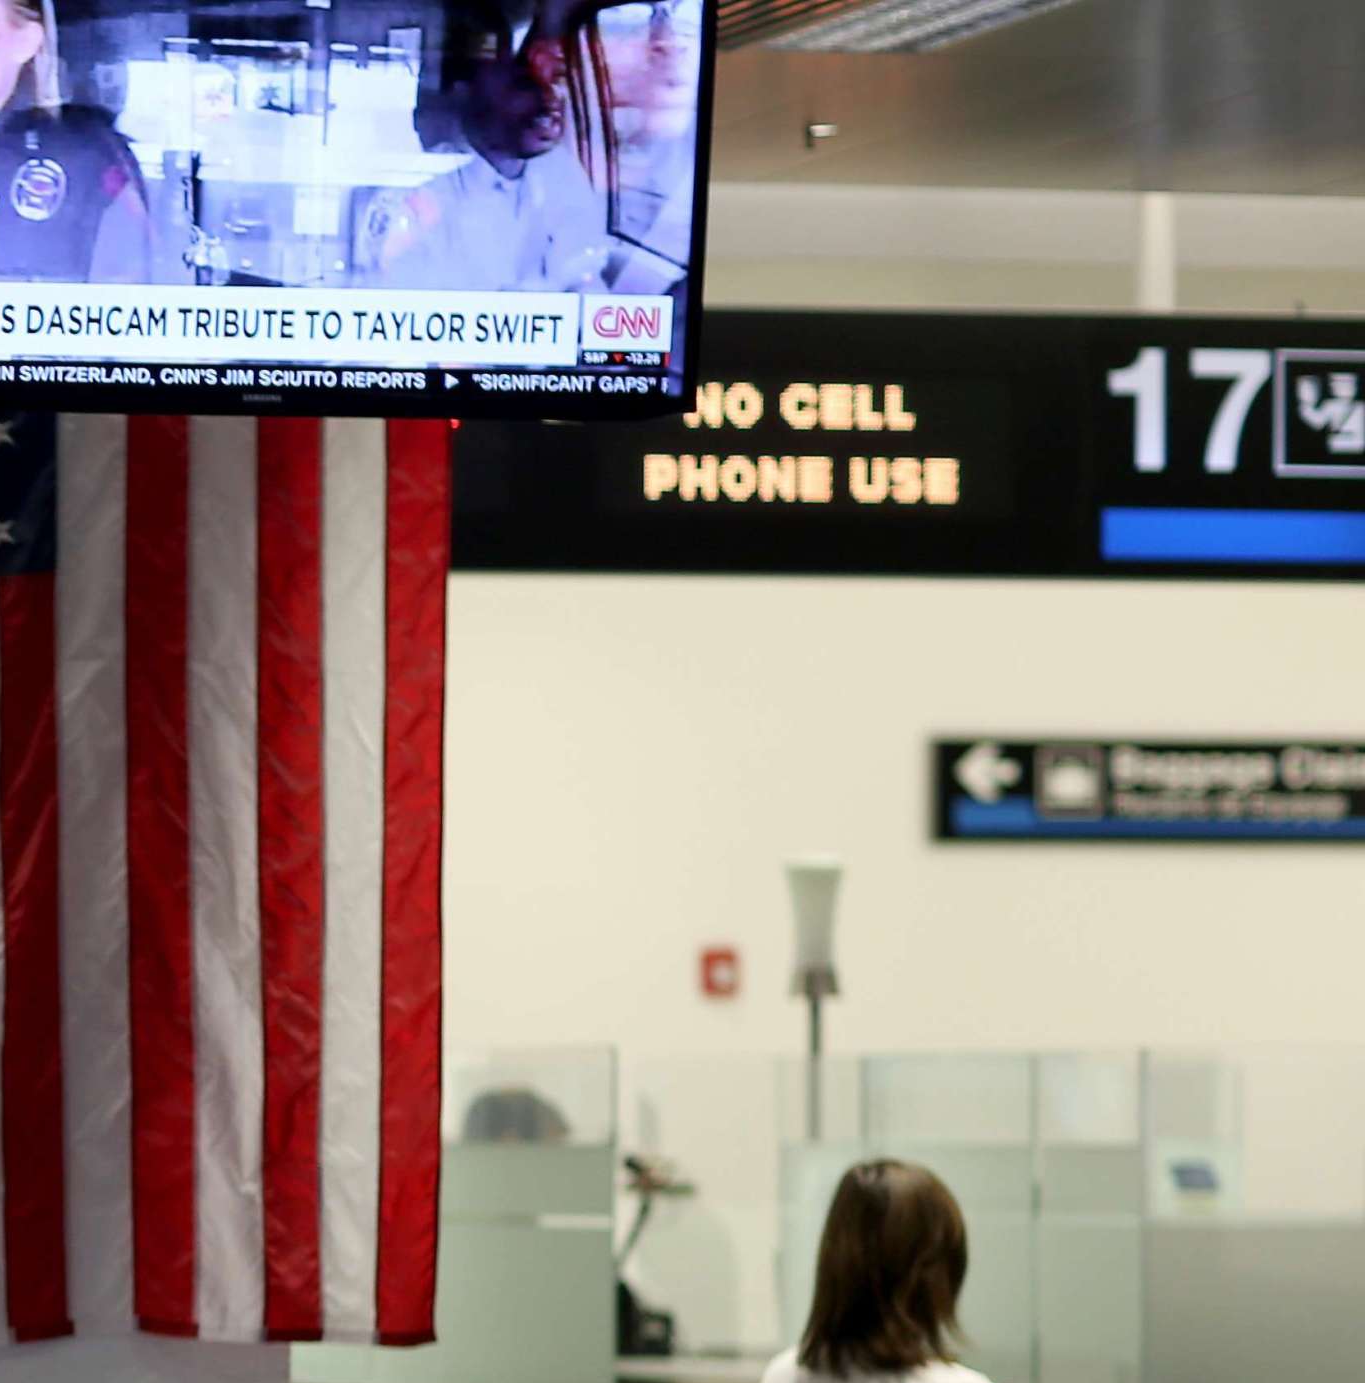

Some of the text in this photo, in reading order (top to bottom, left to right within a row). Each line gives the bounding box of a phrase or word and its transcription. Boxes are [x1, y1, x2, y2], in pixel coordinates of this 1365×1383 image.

[26, 304, 168, 337] DASHCAM
[178, 307, 295, 339] TRIBUTE
[305, 310, 342, 340] TO
[353, 311, 465, 342] TAYLOR
[475, 313, 563, 344] SWIFT
[593, 306, 661, 339] CNN
[18, 366, 156, 386] SWITZERLAND,
[159, 367, 218, 385] CNN'S
[220, 369, 255, 386] JIM
[257, 370, 338, 387] SCIUTTO
[341, 372, 427, 390] REPORTS
[472, 373, 596, 392] "SIGNIFICANT
[598, 375, 657, 393] GAPS"
[779, 382, 917, 431] CELL
[1108, 346, 1273, 473] 17
[643, 453, 961, 505] PHONE USE
